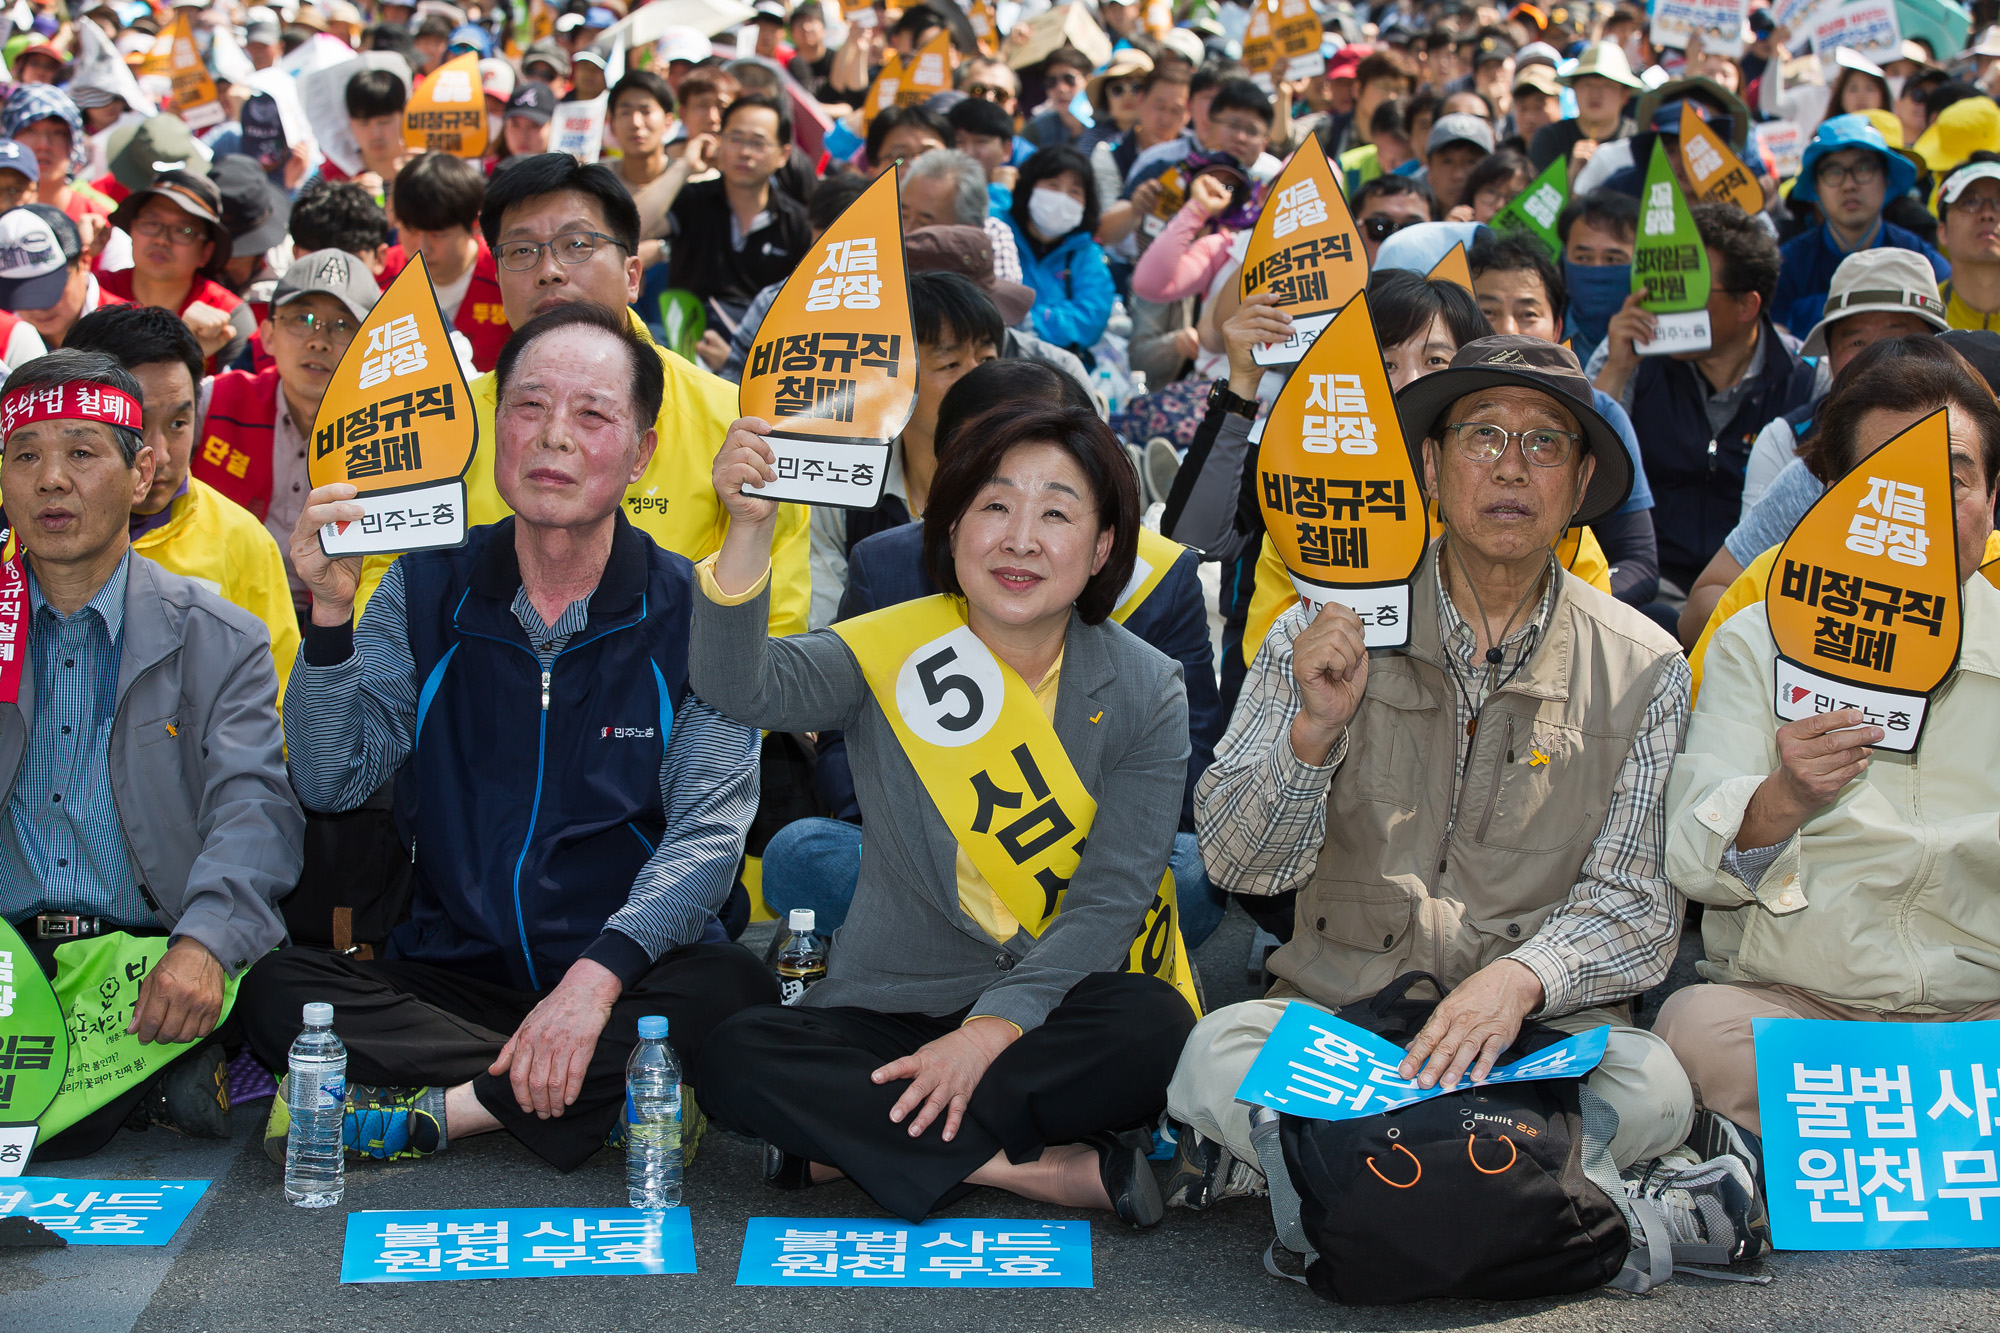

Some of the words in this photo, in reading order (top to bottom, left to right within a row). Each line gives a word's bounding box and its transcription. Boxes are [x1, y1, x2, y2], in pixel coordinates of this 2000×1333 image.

[1275, 177, 1320, 215] 지금
[1273, 200, 1328, 239] 당장
[816, 237, 879, 274] 지금
[1244, 233, 1353, 296] 비정규직
[1635, 244, 1700, 274] 최저임금
[804, 274, 882, 312] 당장
[1267, 270, 1329, 307] 철폐
[366, 313, 421, 352] 지금
[1283, 329, 1323, 349] 민주
[358, 341, 428, 390] 당장
[750, 333, 901, 379] 비정규직
[76, 387, 131, 425] 철폐!
[773, 376, 857, 423] 철폐
[1305, 373, 1368, 413] 지금
[315, 383, 456, 461] 비정규직
[1302, 415, 1378, 455] 당장
[202, 434, 251, 479] 단결
[345, 432, 423, 480] 철폐
[777, 457, 875, 487] 민주노총
[628, 497, 669, 514] 정의당
[1262, 471, 1406, 521] 비정규직
[1857, 476, 1926, 525] 지금
[360, 503, 455, 536] 민주노총
[1297, 522, 1369, 569] 철폐
[1845, 514, 1930, 567] 당장
[1314, 602, 1399, 626] 노총
[1780, 560, 1946, 637] 비정규직
[1814, 615, 1896, 673] 철폐
[915, 645, 984, 732] 5
[614, 727, 654, 738] 민주노총
[92, 1052, 119, 1070] 봄인가?
[115, 1062, 132, 1079] 진짜
[134, 1056, 147, 1071] 봄!
[1786, 1062, 1917, 1139] 불법
[1927, 1063, 2000, 1138] 사
[1474, 1113, 1513, 1127] Bullit
[1516, 1122, 1539, 1138] 22
[29, 1191, 164, 1213] 사드
[1795, 1148, 1929, 1223] 원천
[375, 1220, 509, 1249] 불법
[522, 1218, 662, 1244] 사드
[774, 1229, 908, 1254] 불법
[921, 1230, 1061, 1253] 사드
[374, 1245, 510, 1273] 원천
[522, 1242, 665, 1269] 무효
[771, 1252, 906, 1278] 원천
[919, 1255, 1062, 1280] 무효
